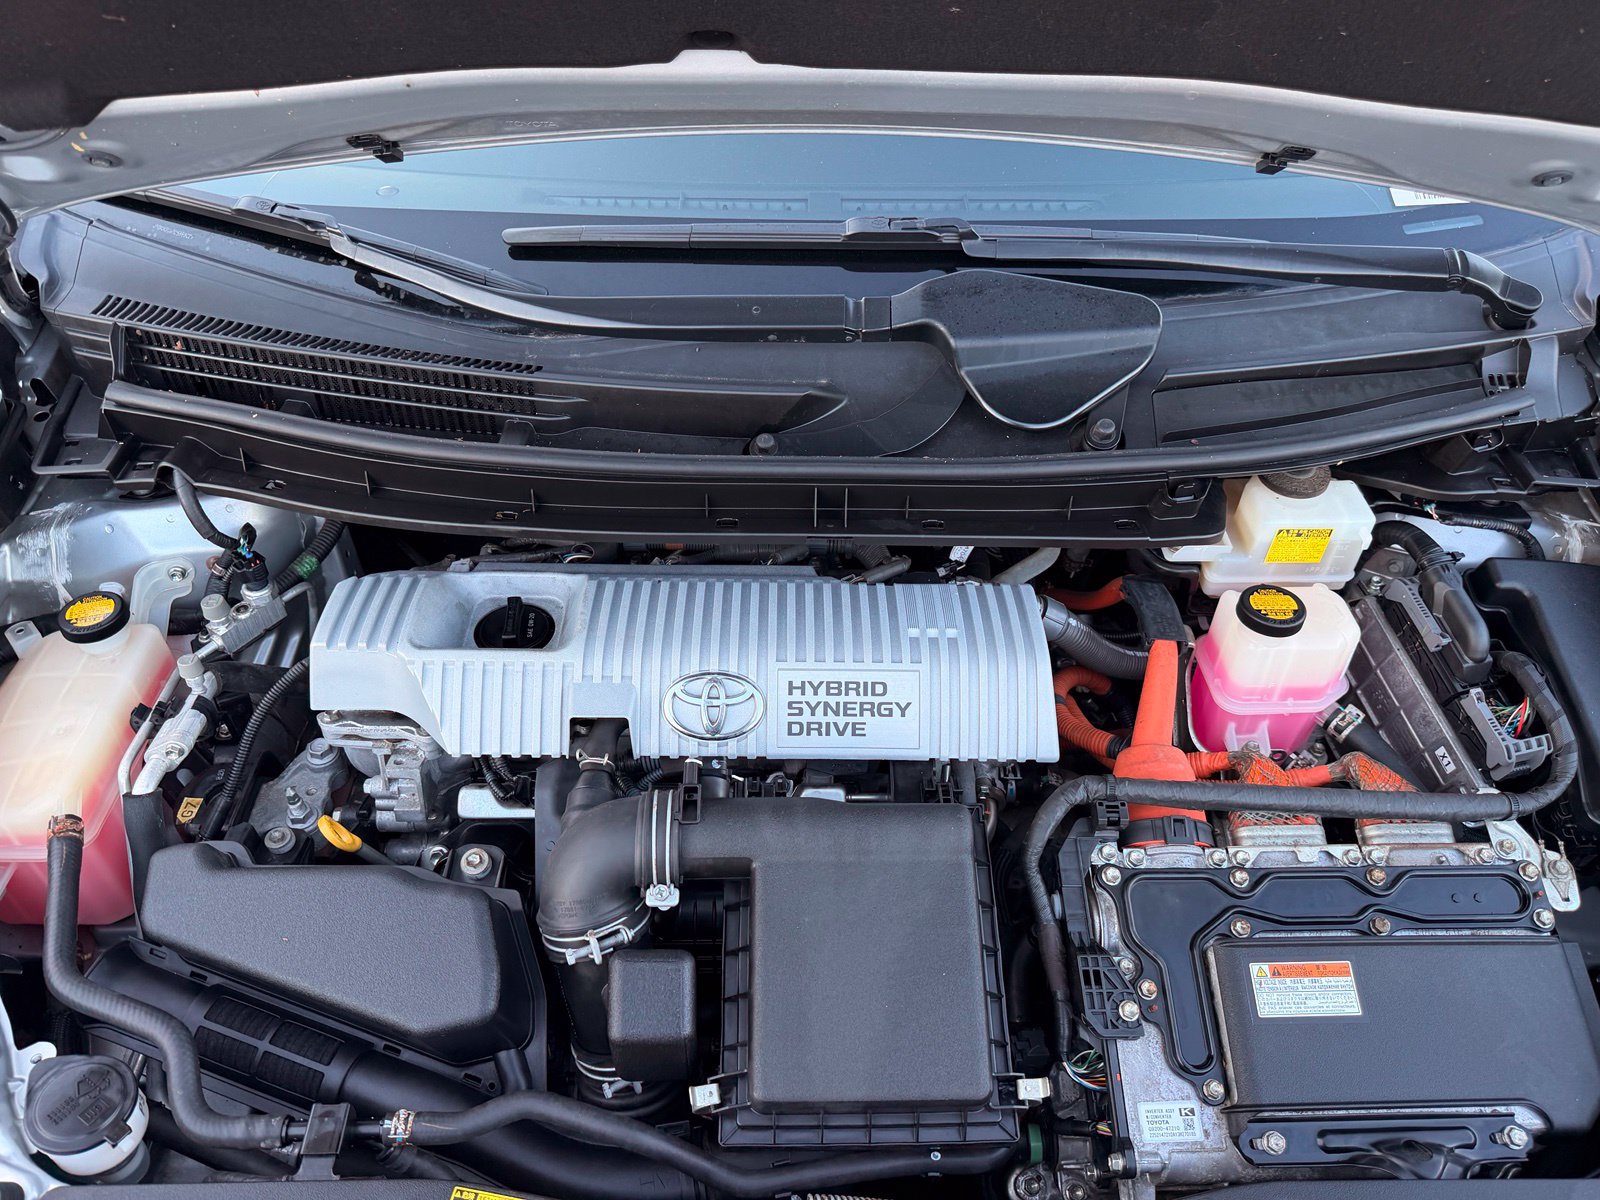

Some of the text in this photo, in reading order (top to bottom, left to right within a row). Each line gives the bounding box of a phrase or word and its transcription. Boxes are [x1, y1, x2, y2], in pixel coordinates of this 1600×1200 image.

[526, 612, 536, 638] SAE 0W-20
[787, 680, 888, 697] HYBRID
[787, 700, 912, 717] SYNERGY
[787, 721, 867, 737] DRIVE
[1439, 752, 1452, 767] X1
[181, 802, 197, 818] G7
